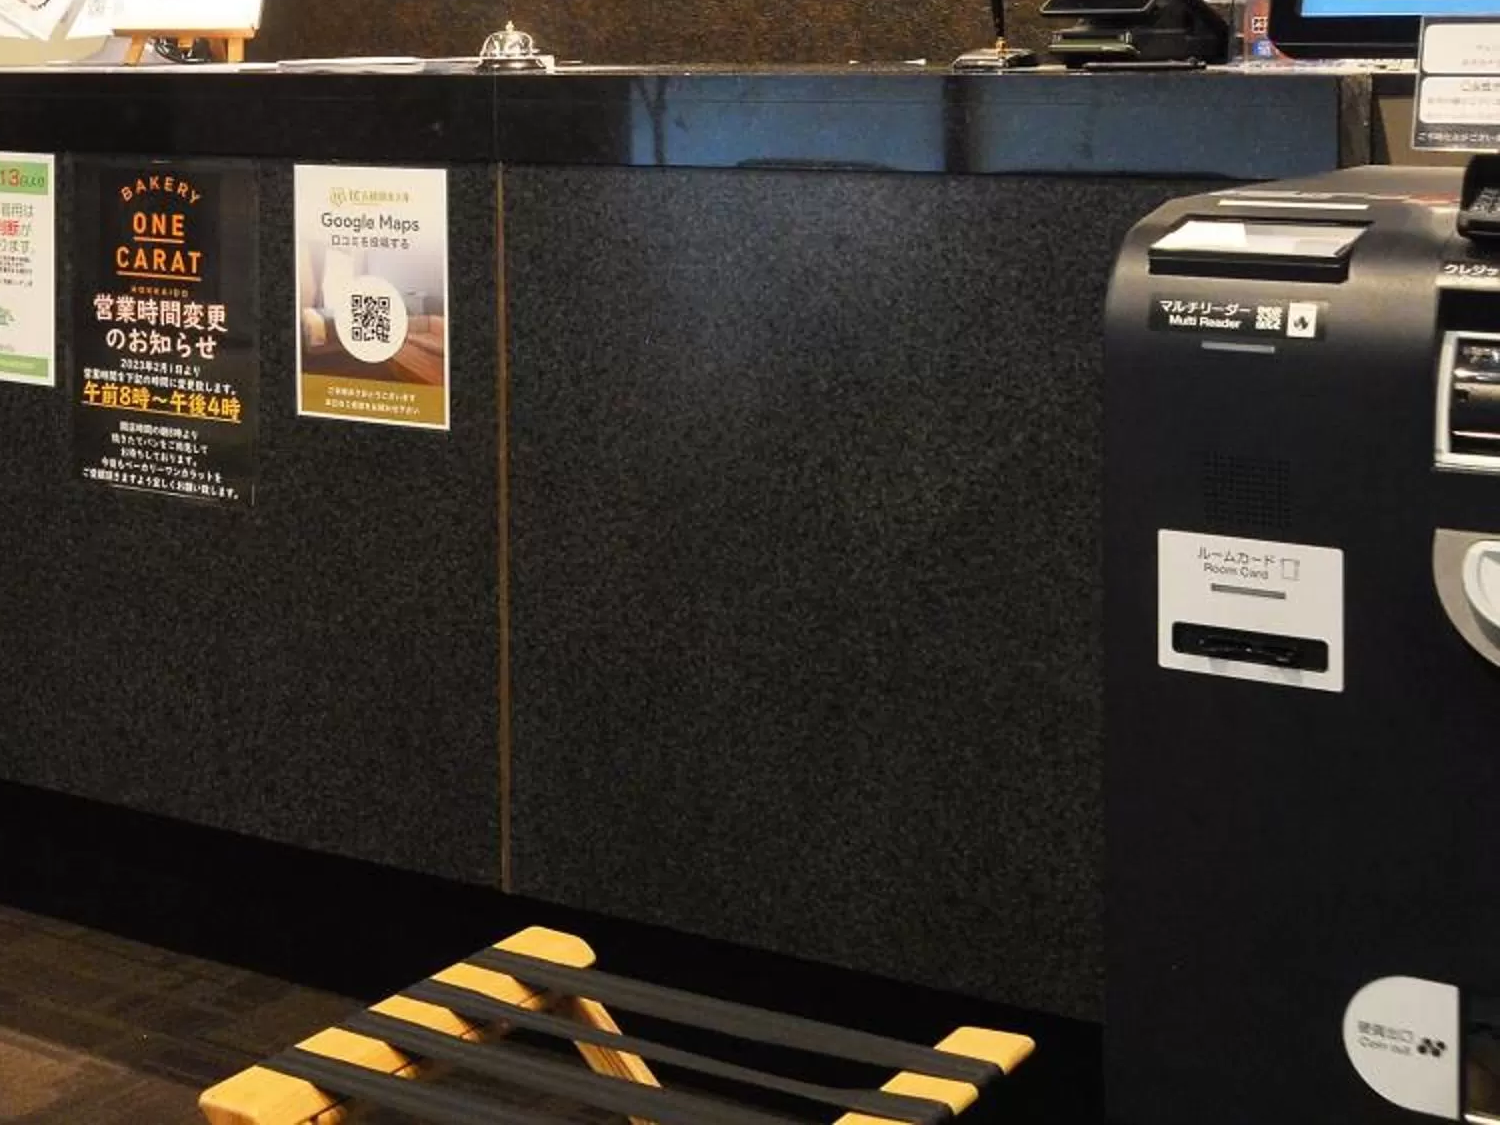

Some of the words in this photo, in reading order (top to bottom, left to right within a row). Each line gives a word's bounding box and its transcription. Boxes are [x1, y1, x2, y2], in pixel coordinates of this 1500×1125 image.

[119, 175, 201, 205] BAKERY
[132, 211, 186, 238] ONE
[321, 212, 375, 233] Google
[379, 214, 420, 234] Maps
[115, 245, 203, 275] CARAT
[93, 293, 228, 332] 営業時間変更
[1160, 299, 1251, 317] マルチリーダー
[1169, 314, 1196, 328] Multi
[1197, 316, 1243, 331] Reader
[105, 328, 218, 360] のお知らせ
[1196, 546, 1277, 567] ルームカード
[1203, 562, 1237, 578] Room
[1239, 565, 1270, 580] Card
